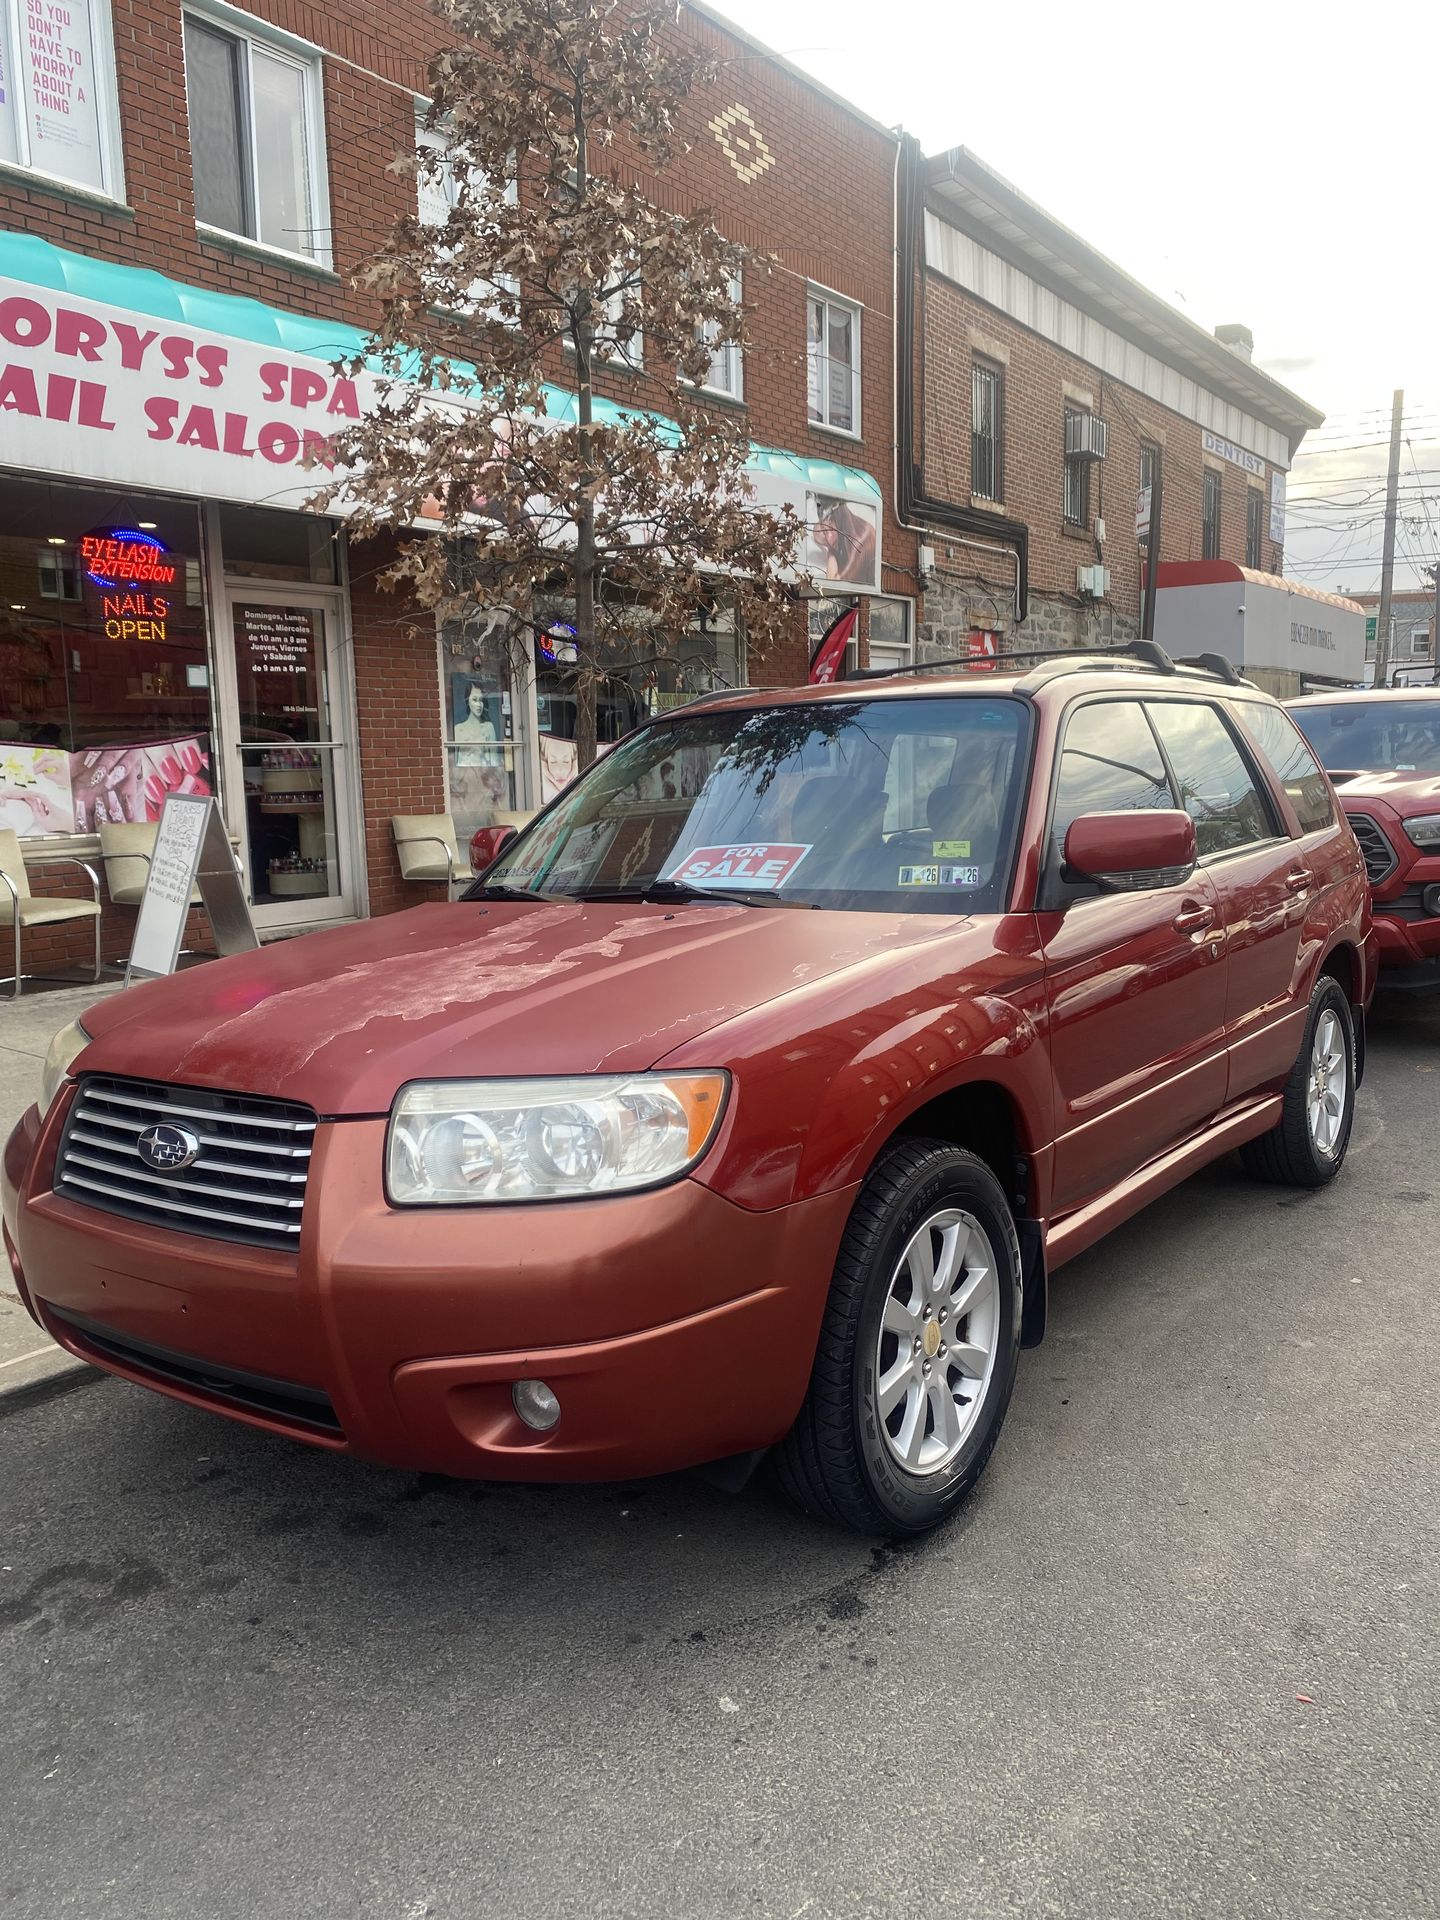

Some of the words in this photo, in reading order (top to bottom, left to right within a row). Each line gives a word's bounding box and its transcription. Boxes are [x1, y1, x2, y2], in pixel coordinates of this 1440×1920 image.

[26, 0, 42, 15] SO
[46, 3, 71, 26] YOU
[28, 14, 62, 41] DON'T
[29, 32, 63, 59] HAVE
[66, 47, 82, 66] TO
[30, 51, 75, 81] WORRY
[32, 71, 72, 98] ABOUT
[77, 87, 86, 104] A
[33, 88, 70, 115] THING
[259, 362, 360, 419] SPA
[144, 396, 338, 474] SALON
[1205, 433, 1262, 474] DENTIST
[82, 537, 160, 565] EYELASH
[90, 558, 175, 583] EXTENSION
[103, 594, 168, 618] NAILS
[244, 610, 283, 621] Domingos,
[284, 613, 308, 623] Lunes,
[105, 619, 165, 640] OPEN
[245, 622, 274, 633] Martes,
[275, 624, 310, 634] Miercoles
[260, 634, 269, 642] 10
[250, 643, 278, 652] Jueves,
[280, 644, 307, 653] Viernes
[269, 653, 296, 661] Sabado
[252, 664, 261, 672] de
[723, 847, 768, 859] FOR
[682, 858, 789, 879] SALE
[926, 868, 936, 882] 26
[967, 868, 977, 883] 26
